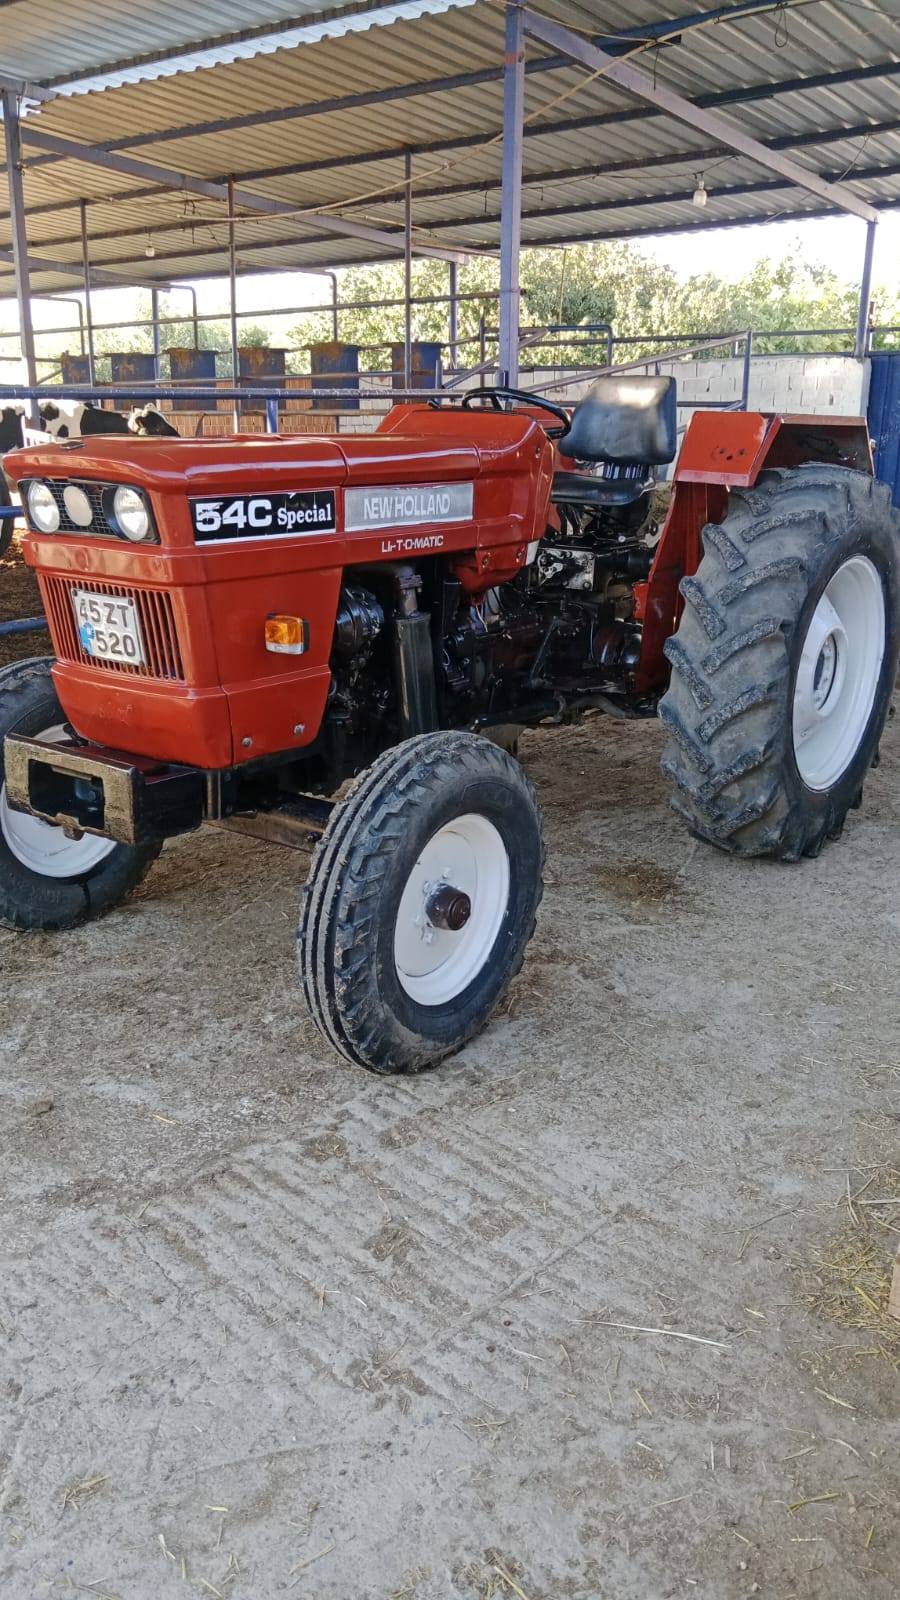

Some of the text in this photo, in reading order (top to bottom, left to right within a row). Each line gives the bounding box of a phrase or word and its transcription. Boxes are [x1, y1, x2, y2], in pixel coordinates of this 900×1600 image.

[195, 499, 332, 532] 54C Special
[364, 494, 451, 520] NEW HOLLAND
[95, 629, 136, 657] 520
